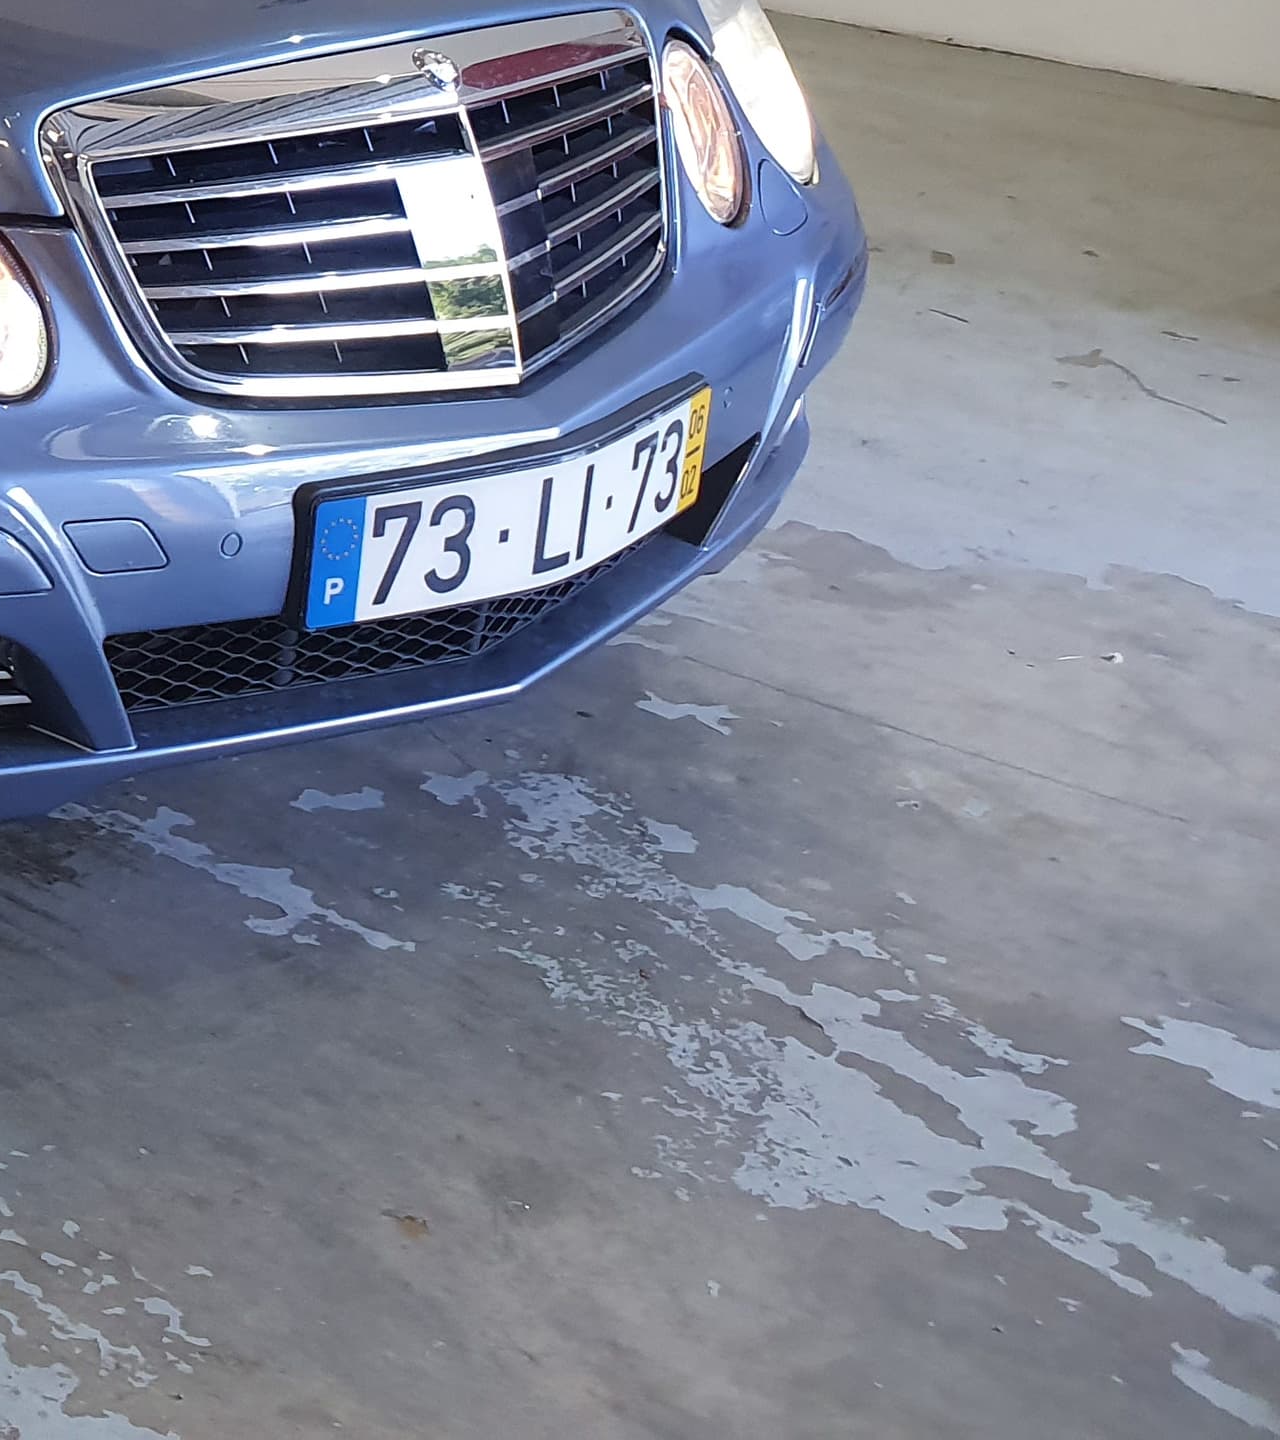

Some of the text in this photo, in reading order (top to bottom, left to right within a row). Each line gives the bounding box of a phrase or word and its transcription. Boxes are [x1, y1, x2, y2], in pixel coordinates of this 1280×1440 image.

[689, 404, 706, 440] 06
[680, 464, 697, 500] 02
[323, 577, 345, 606] P
